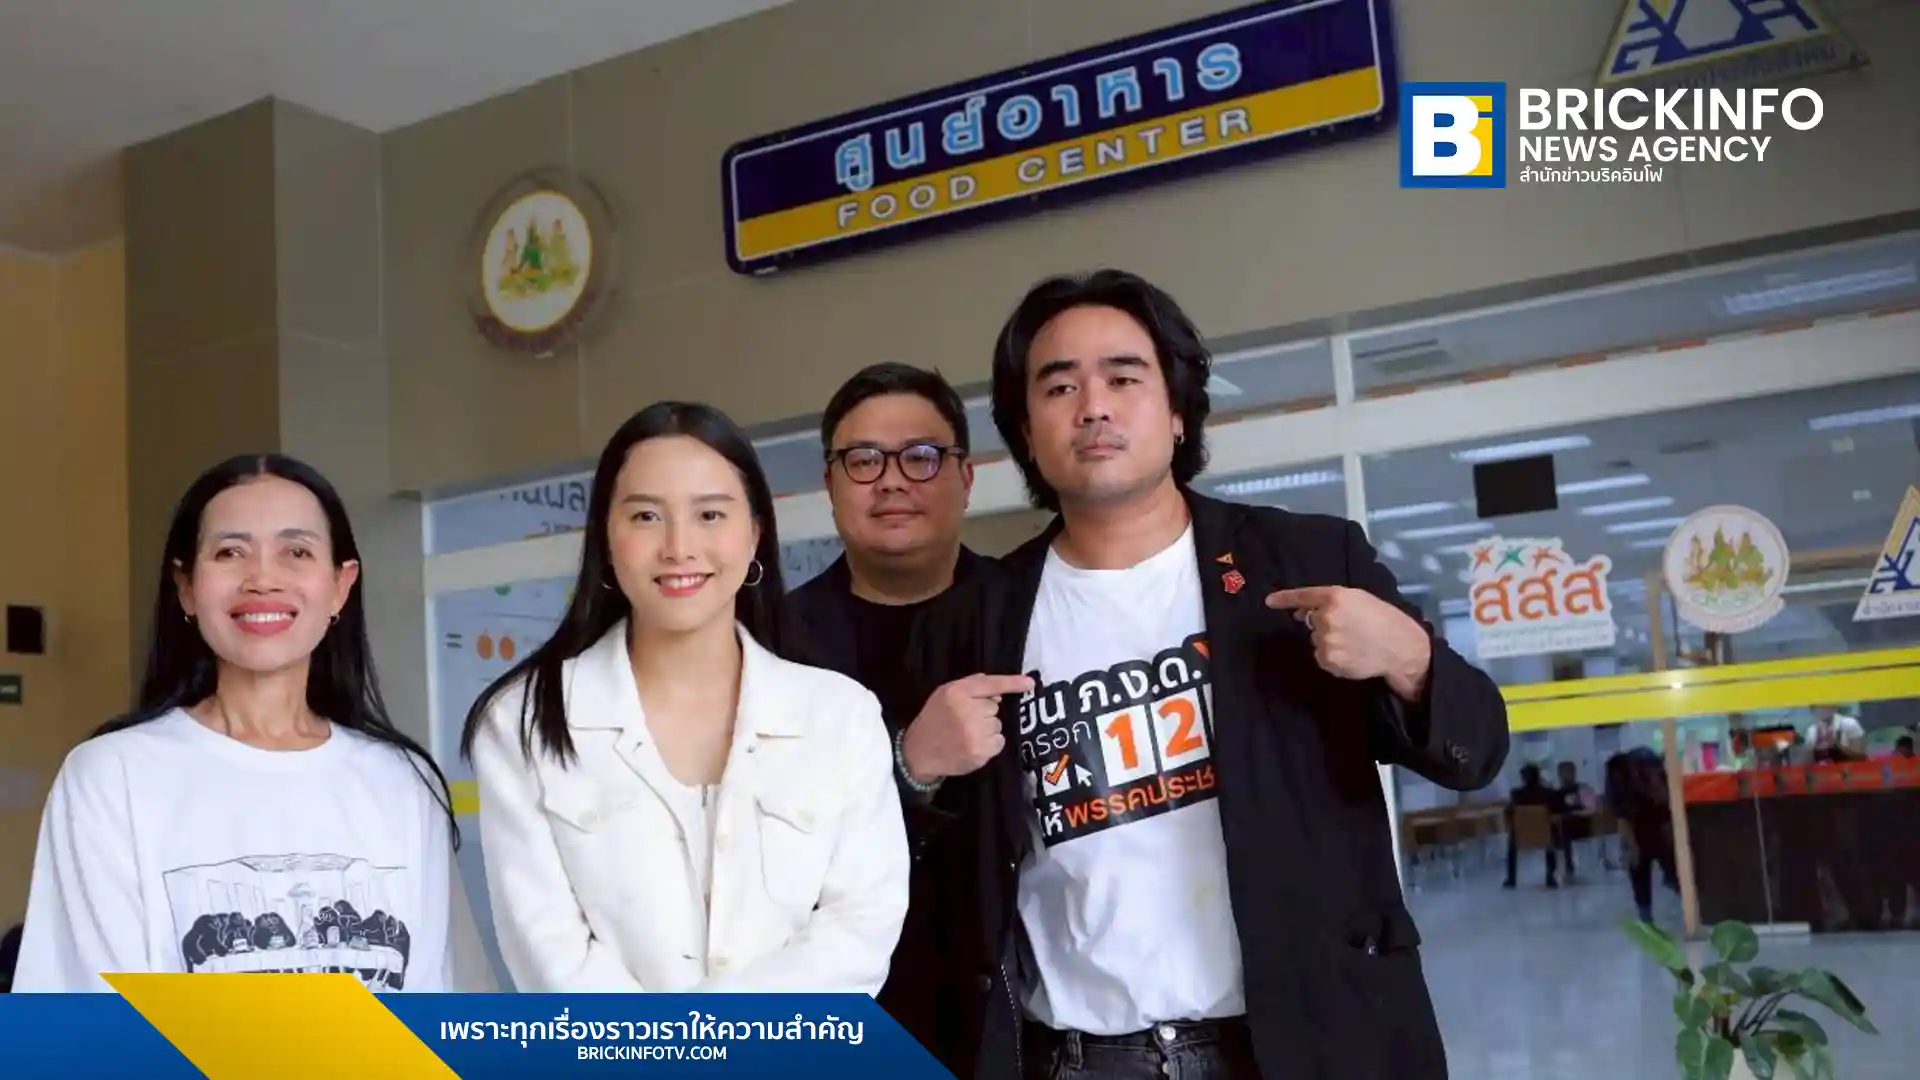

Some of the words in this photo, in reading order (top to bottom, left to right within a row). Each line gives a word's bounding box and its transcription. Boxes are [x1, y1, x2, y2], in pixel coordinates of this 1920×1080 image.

[835, 42, 1243, 192] ศูนย์อาหาร
[837, 175, 977, 229] FOOD
[1017, 108, 1250, 183] CENTER
[1473, 562, 1605, 626] สสส
[1078, 656, 1203, 714] ภ.ง.ด.
